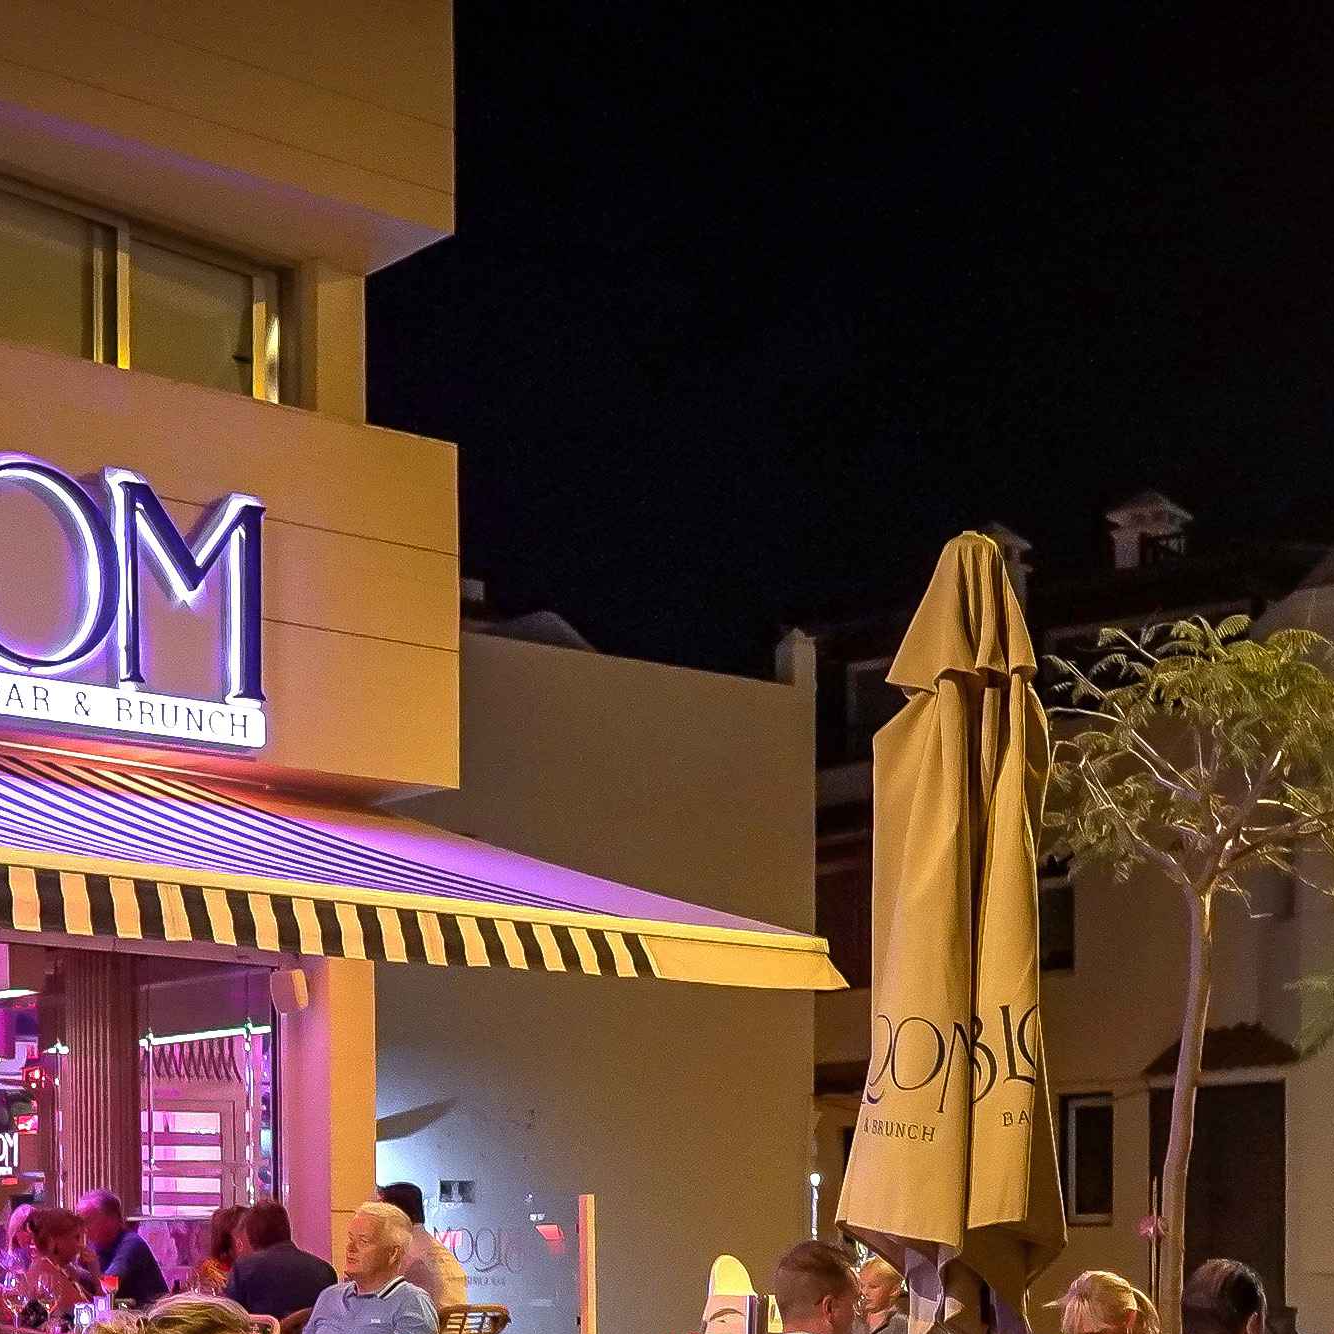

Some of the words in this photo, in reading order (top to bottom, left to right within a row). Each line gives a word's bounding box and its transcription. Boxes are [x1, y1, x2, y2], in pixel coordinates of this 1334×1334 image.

[74, 691, 91, 717] &
[116, 697, 249, 739] BRUNCH
[871, 1119, 936, 1143] BRUNCH
